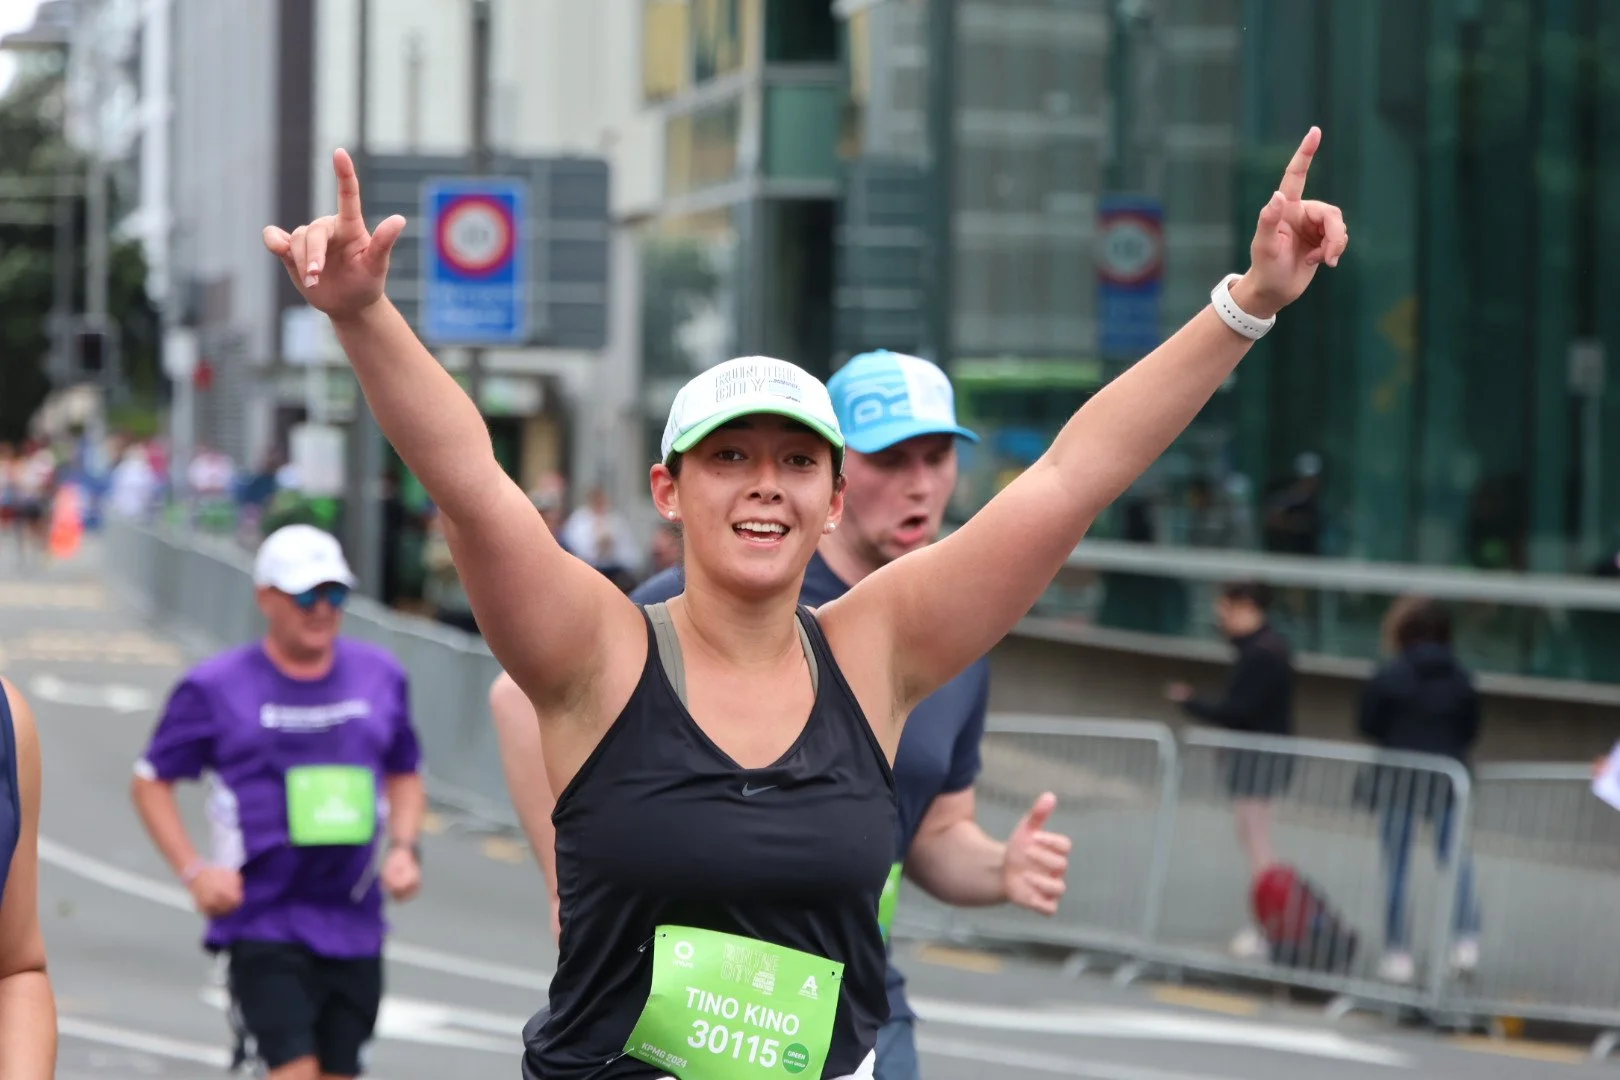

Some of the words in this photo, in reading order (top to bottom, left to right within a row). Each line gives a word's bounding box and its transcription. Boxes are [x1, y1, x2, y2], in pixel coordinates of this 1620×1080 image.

[716, 365, 757, 388] RUN
[716, 378, 765, 403] CITY
[685, 986, 739, 1020] TINO
[743, 1003, 800, 1036] KINO
[641, 1042, 666, 1058] KPMG
[666, 1053, 688, 1068] 2024
[687, 1020, 780, 1068] 30115
[787, 1050, 806, 1060] GREEN
